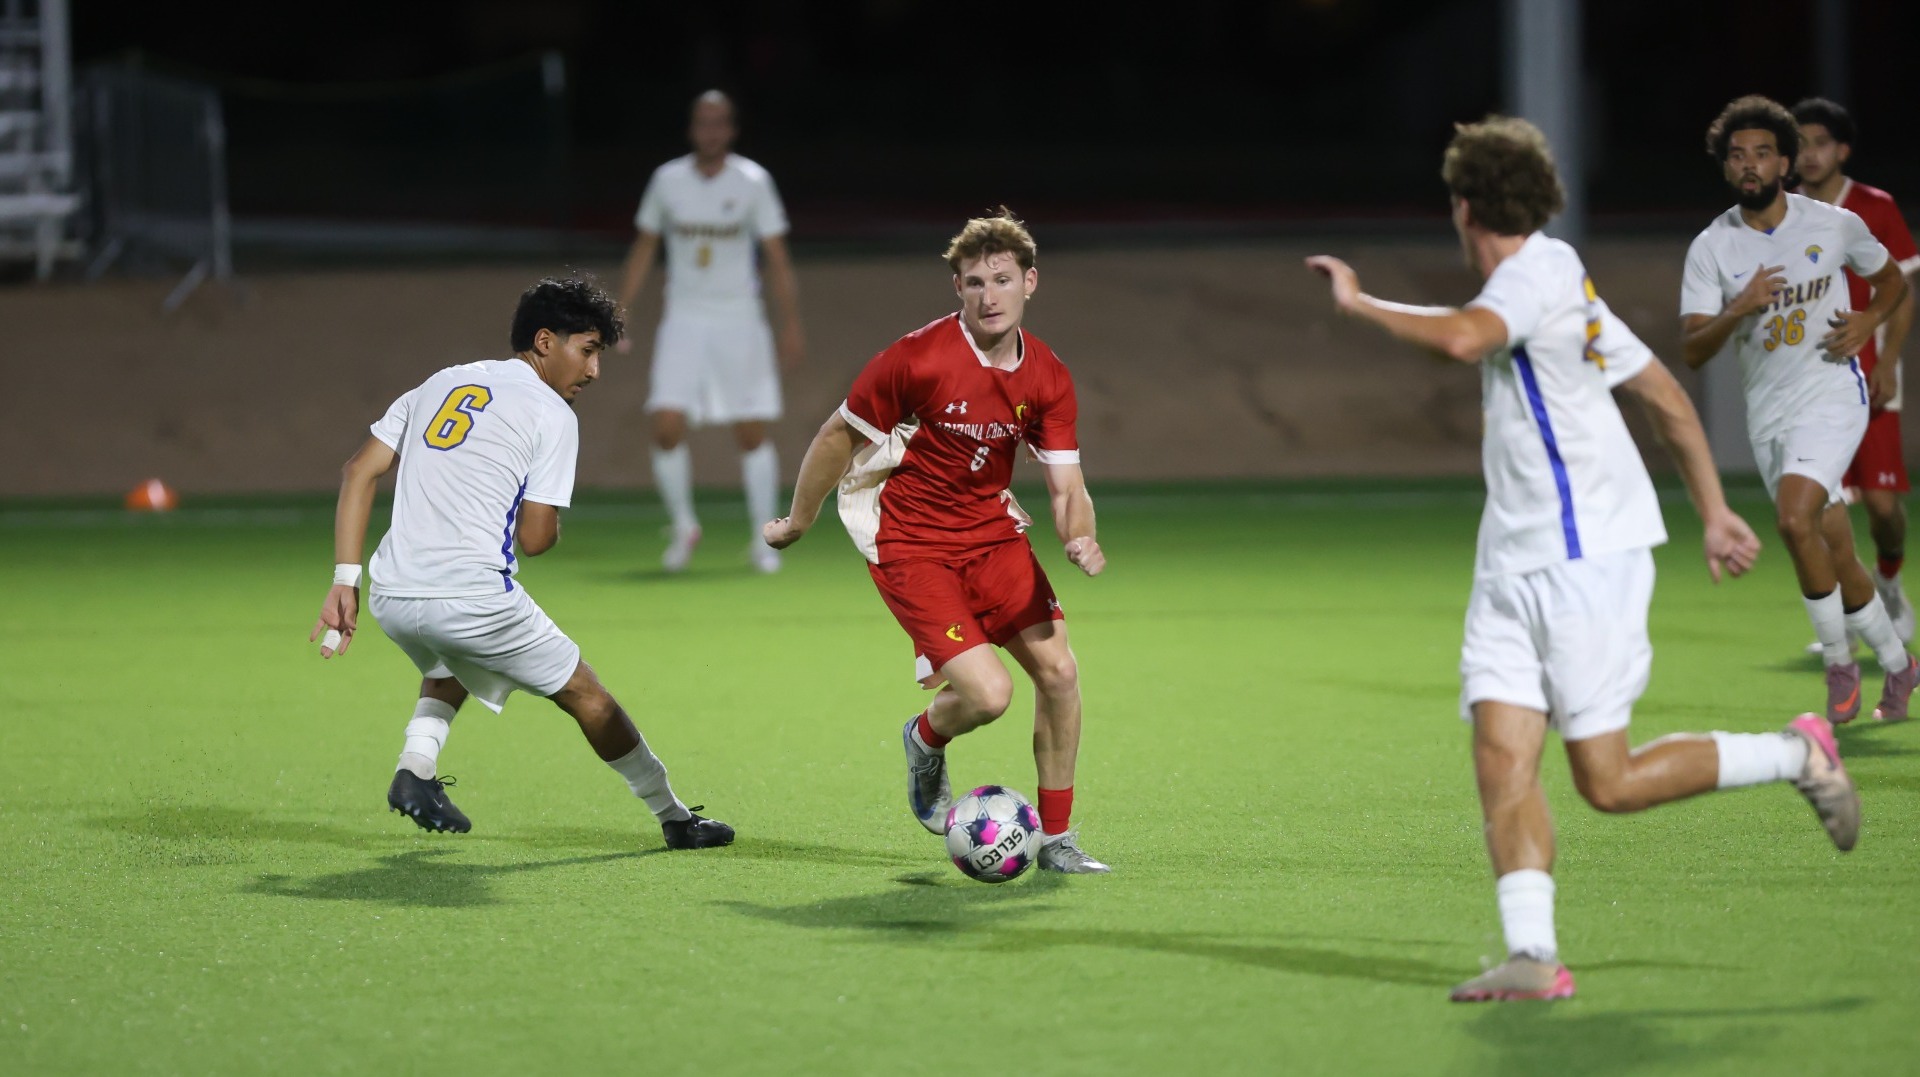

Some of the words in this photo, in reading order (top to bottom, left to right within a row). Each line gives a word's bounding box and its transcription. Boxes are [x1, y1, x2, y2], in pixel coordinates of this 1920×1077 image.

[1764, 308, 1807, 351] 36
[422, 383, 493, 451] 6
[975, 827, 1024, 871] SELECT
